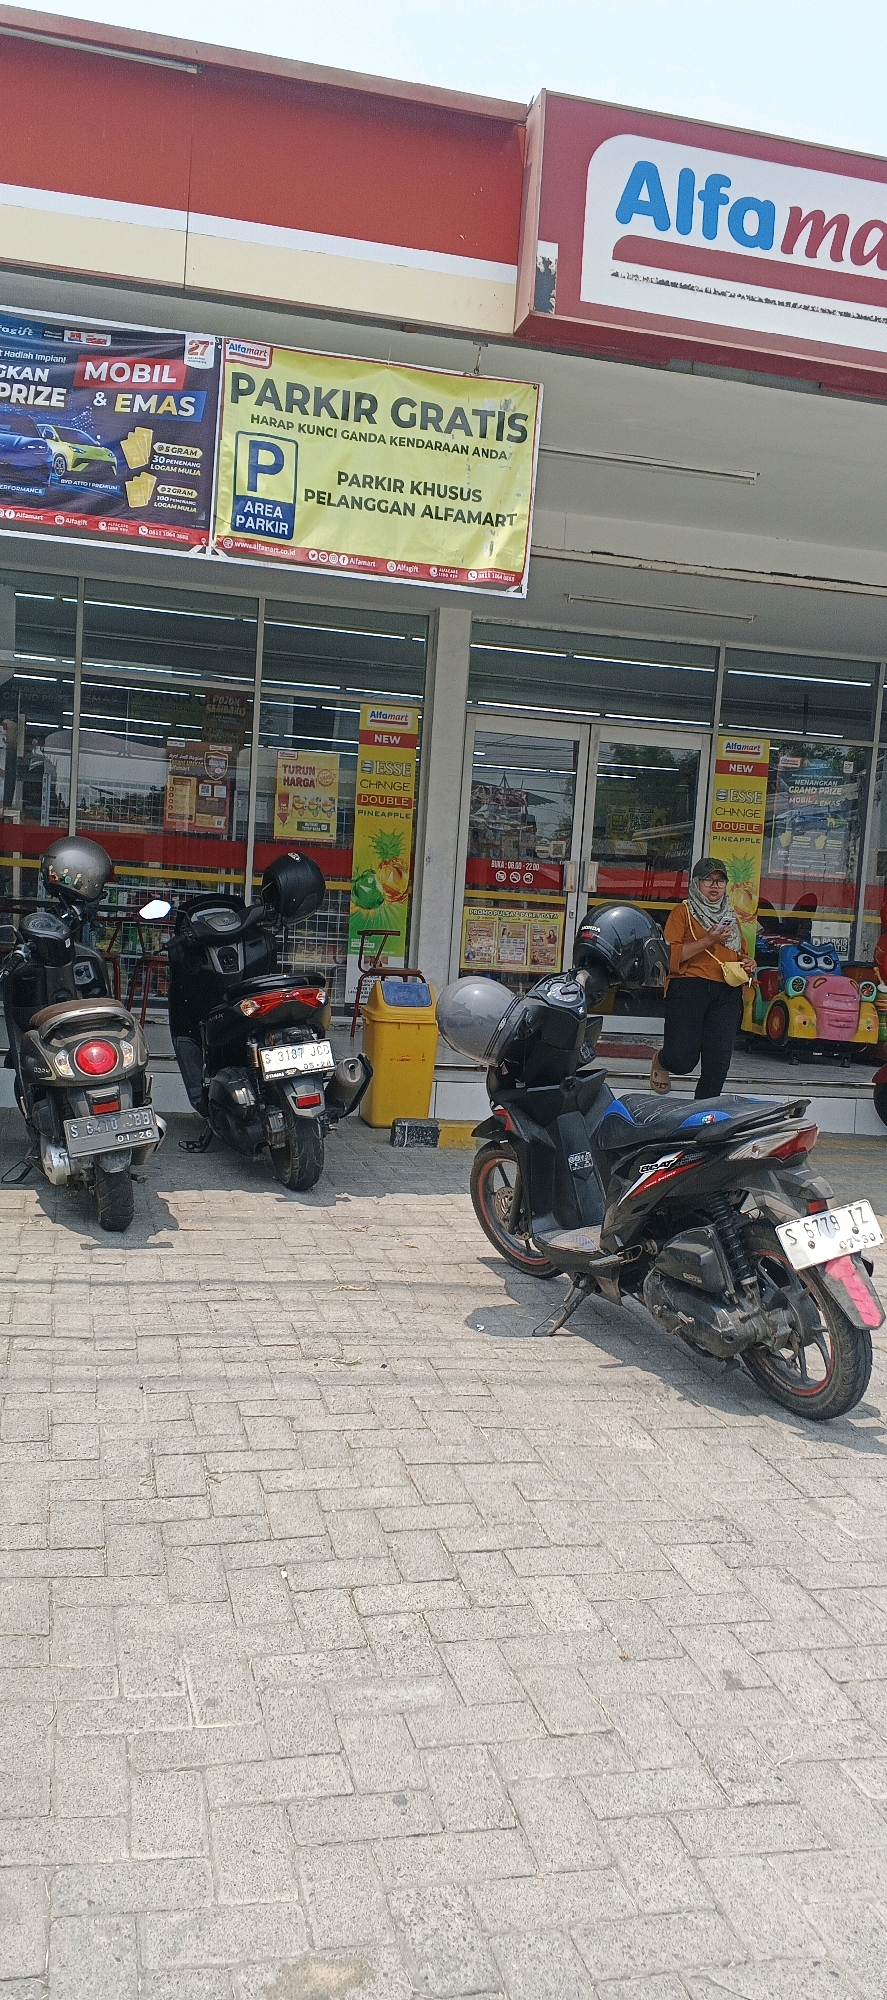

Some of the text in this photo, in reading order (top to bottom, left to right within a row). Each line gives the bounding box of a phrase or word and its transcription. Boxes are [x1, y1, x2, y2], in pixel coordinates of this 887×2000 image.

[229, 342, 268, 358] Alfamart
[4, 350, 34, 360] Hadiah
[36, 353, 66, 364] Impian!
[84, 361, 177, 383] MOBIL
[93, 391, 196, 417] & EMAS
[230, 372, 529, 444] PARKIR GRATIS
[250, 414, 508, 460] HARAP KUNCI GANDA KENDARAAN ANDA
[171, 446, 198, 456] GRAM
[152, 455, 201, 468] 30 PEMENANG
[247, 440, 285, 492] P
[150, 464, 201, 476] LOGAM MULIA
[92, 483, 118, 491] PREMIUM
[172, 488, 194, 496] GRAM
[337, 471, 483, 503] PARKIR KHUSUS
[154, 502, 197, 513] LOGAM MULIA
[244, 500, 283, 519] AREA
[304, 488, 518, 528] PELANGGAN ALFAMART
[16, 512, 44, 521] Alfamart
[65, 518, 88, 526] Alfagift
[236, 515, 289, 535] PARKIR
[234, 541, 296, 556] www.alfamart.co.id
[350, 557, 376, 568] Alfamart
[396, 564, 419, 573] Alfagift
[370, 710, 409, 721] Alfamart
[374, 734, 401, 744] NEW
[726, 742, 761, 752] Alfamart
[282, 764, 316, 776] TURUN
[376, 761, 412, 777] ESSE
[729, 764, 754, 773] NEW
[282, 776, 316, 788] HARGA
[360, 779, 410, 792] CHANGE
[730, 789, 762, 804] ESSE
[788, 786, 842, 795] GRAND PRIZE
[361, 795, 409, 806] DOUBLE
[788, 796, 813, 804] MOBIL
[358, 809, 411, 819] PINEAPPLE
[715, 806, 761, 818] CHANGE
[716, 822, 760, 832] DOUBLE
[713, 836, 761, 844] PINEAPPLE
[491, 860, 504, 868] BUKA
[526, 862, 540, 870] 22.00
[469, 908, 492, 916] PROMO
[822, 938, 848, 946] PARKIR
[265, 1054, 272, 1064] S
[278, 1048, 303, 1062] 3187
[70, 1124, 78, 1138] S
[785, 1206, 868, 1246] S 6779 IZ
